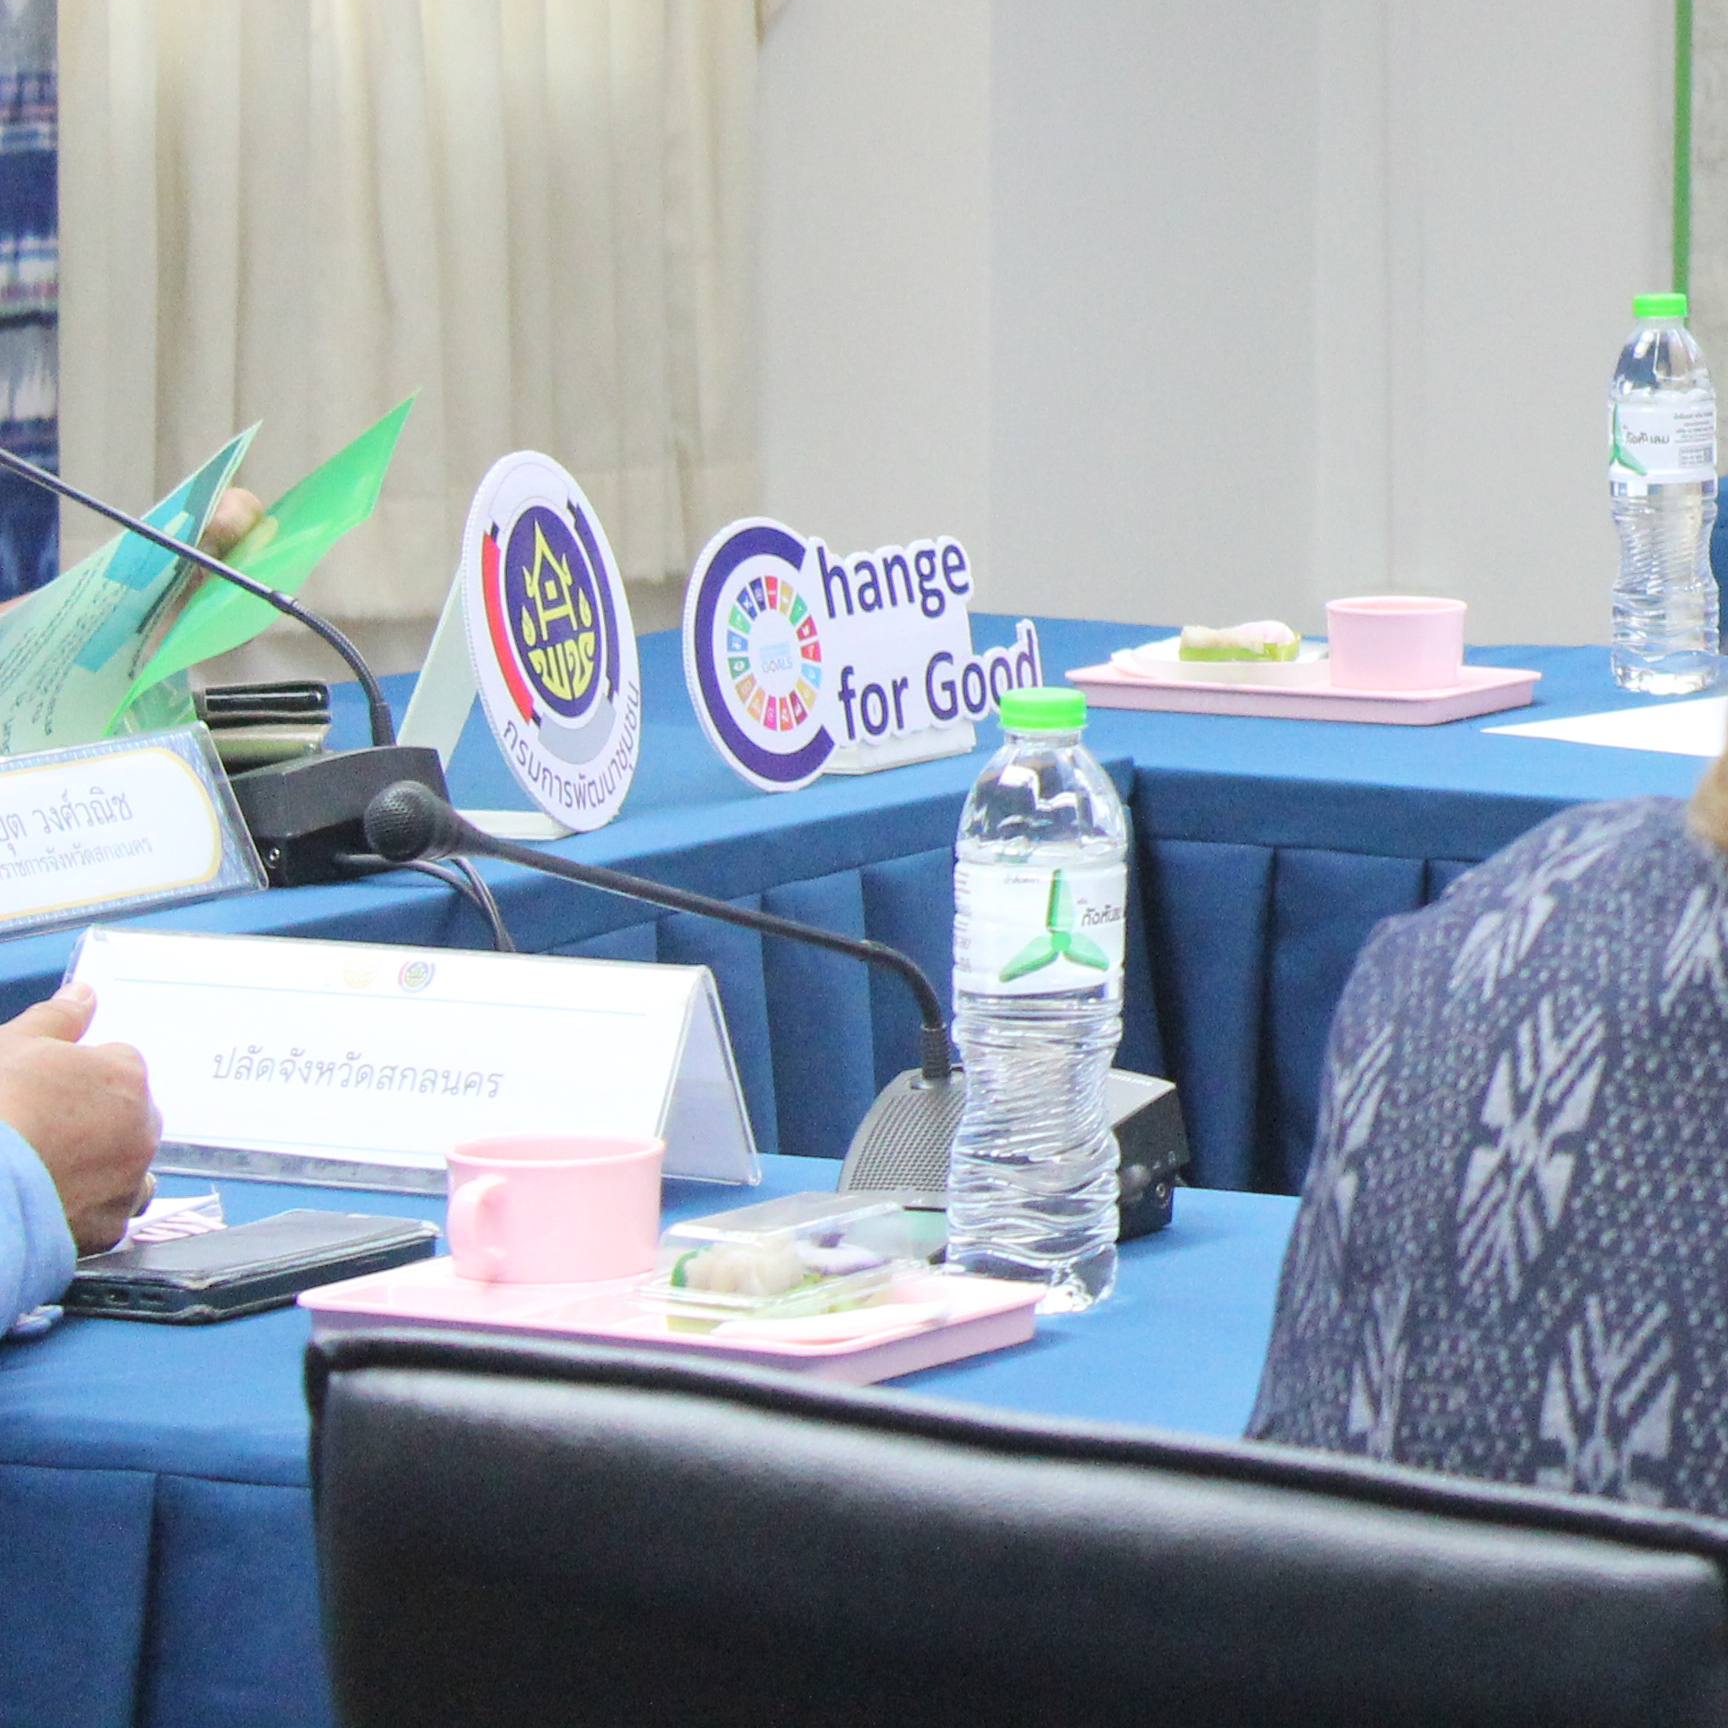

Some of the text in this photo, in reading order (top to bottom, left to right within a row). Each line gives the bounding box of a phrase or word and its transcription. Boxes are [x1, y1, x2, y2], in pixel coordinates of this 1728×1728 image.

[838, 628, 1039, 741] for Good
[211, 1044, 504, 1099] ปลัดจังหวัดสกลนคร
